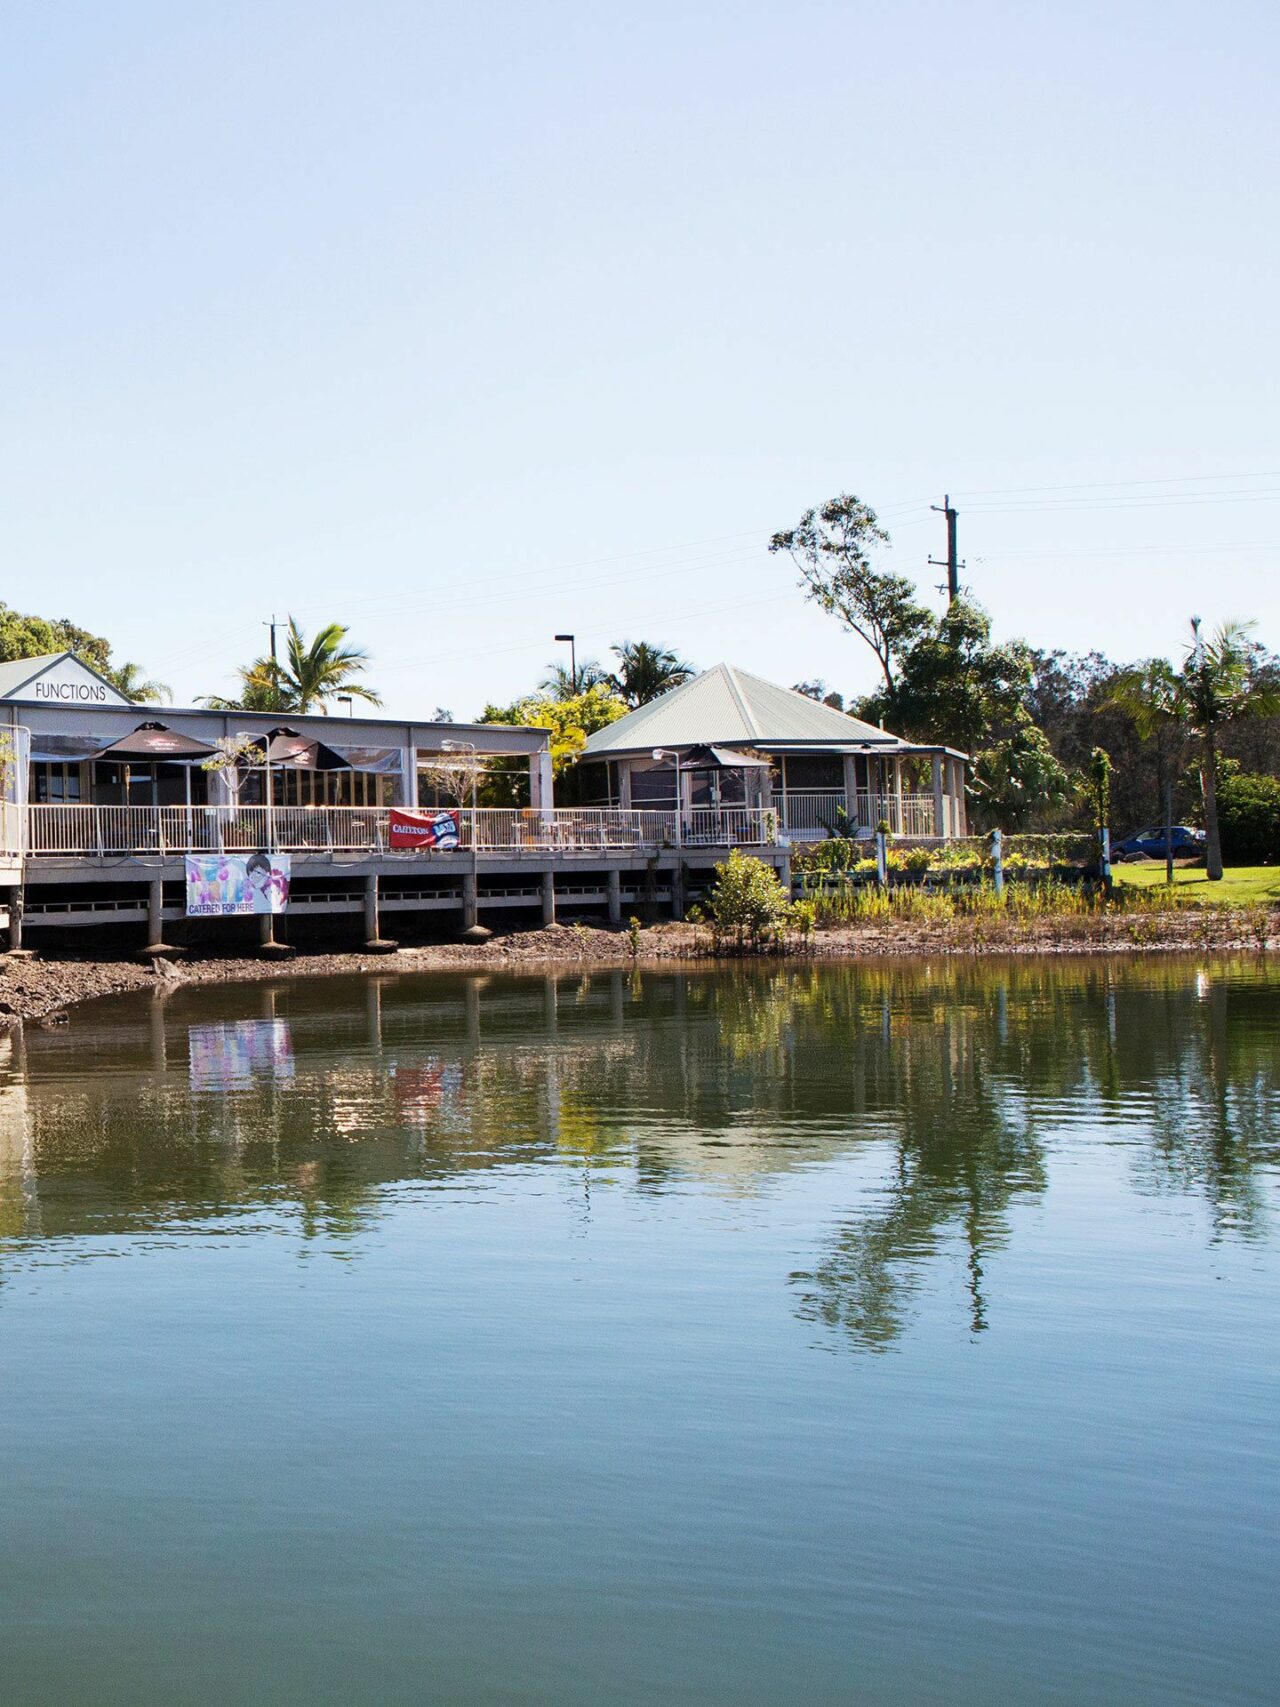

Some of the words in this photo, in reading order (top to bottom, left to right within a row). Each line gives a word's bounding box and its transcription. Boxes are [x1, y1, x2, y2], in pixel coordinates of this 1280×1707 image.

[35, 682, 106, 701] FUNCTIONS
[392, 823, 429, 835] CARLTON
[188, 903, 220, 914] CATERED
[222, 903, 236, 913] FOR
[237, 902, 254, 912] HERE
